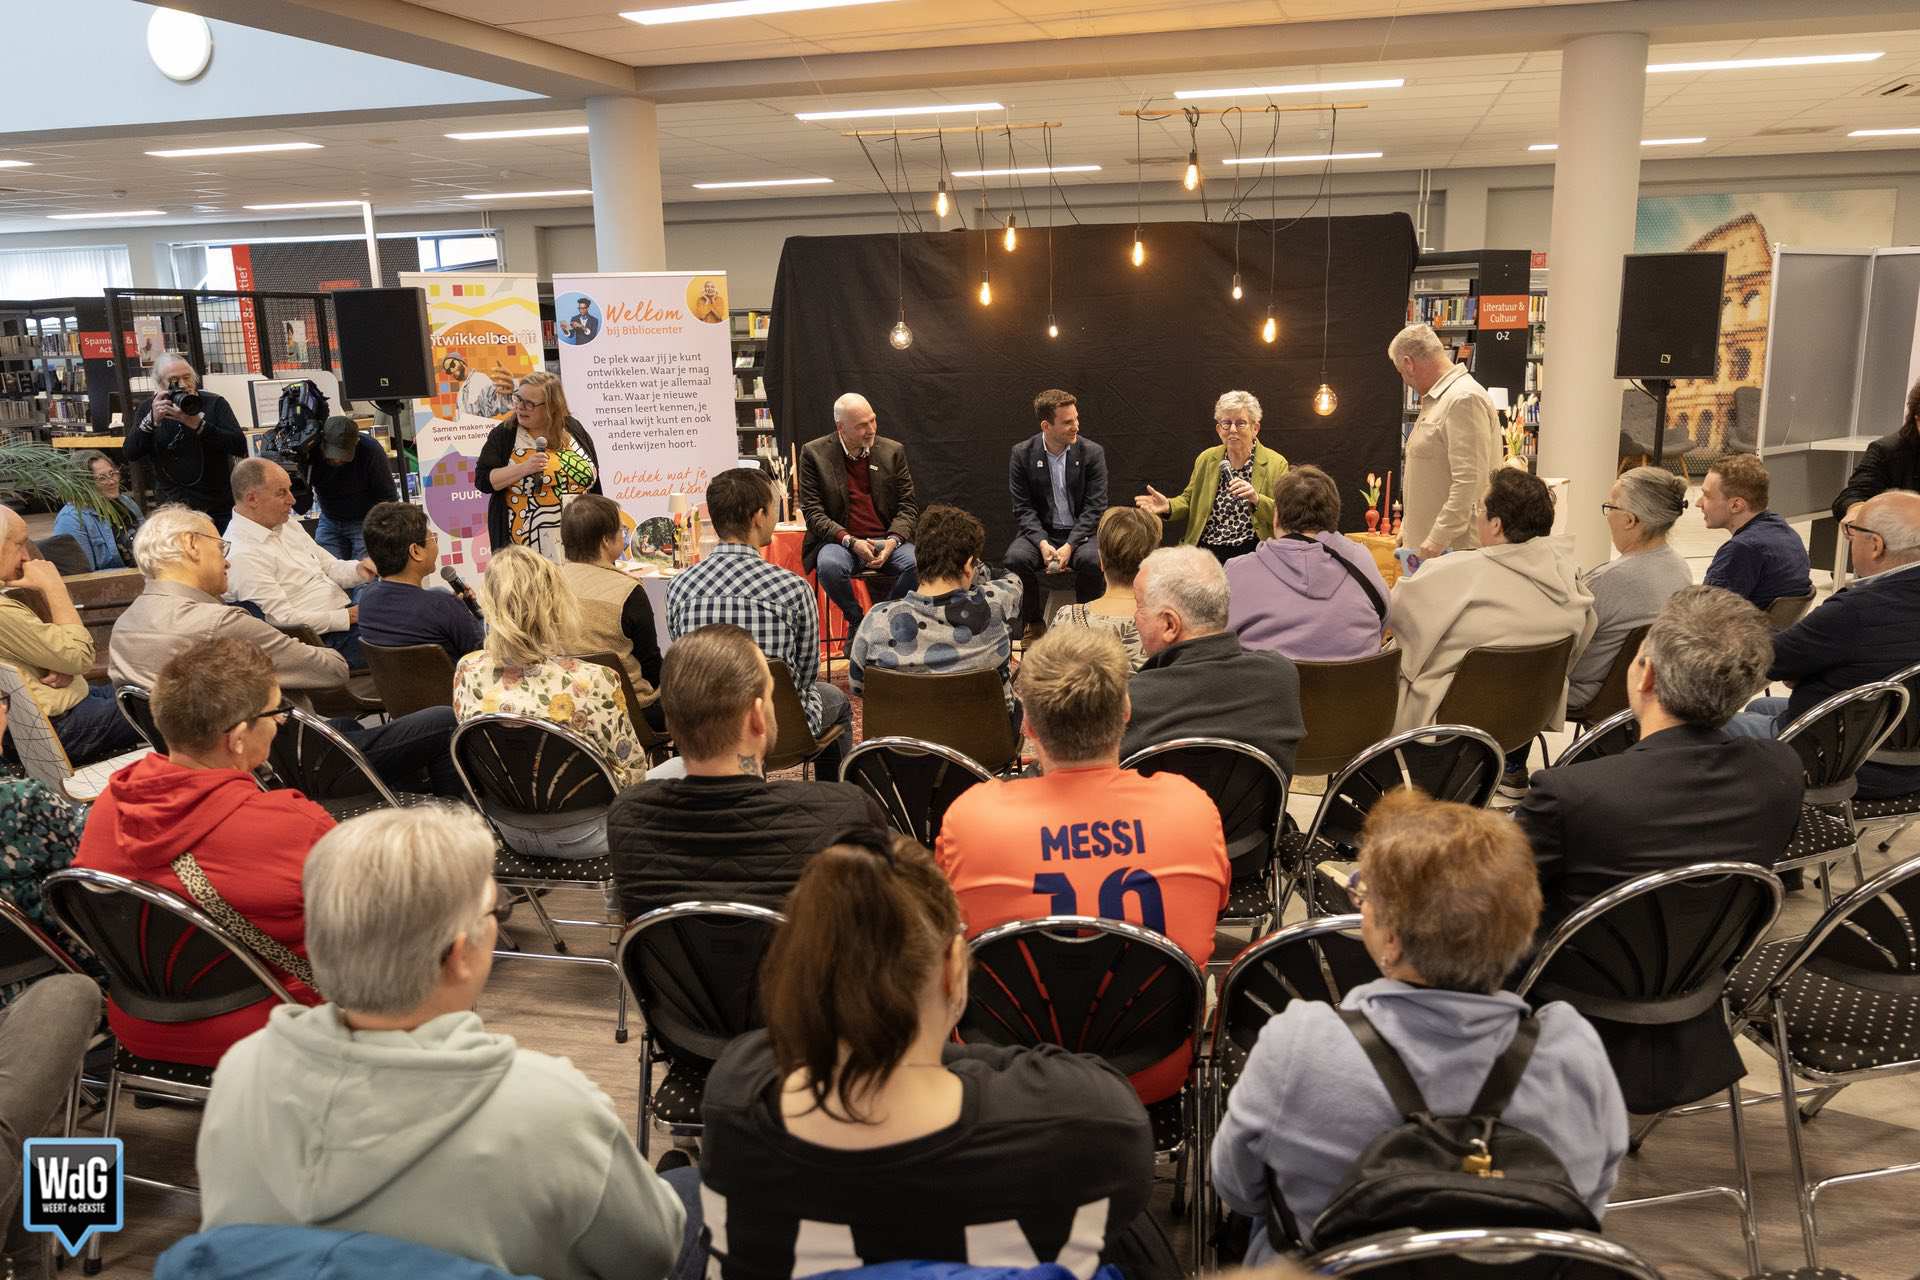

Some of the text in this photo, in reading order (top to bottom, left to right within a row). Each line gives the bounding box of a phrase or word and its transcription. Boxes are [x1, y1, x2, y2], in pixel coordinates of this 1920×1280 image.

[605, 300, 682, 323] Welkom
[1483, 301, 1525, 312] Literatuur &
[1490, 313, 1517, 323] Cultuur
[606, 325, 682, 337] bij Bibliocenter
[1496, 331, 1510, 341] O-Z
[126, 336, 133, 345] &
[430, 329, 536, 347] twikkelbedrijf
[593, 352, 701, 366] De plek waar jij je kunt
[587, 365, 709, 377] ontwikkelen. Waar je mag
[587, 377, 711, 390] ontdekken wat je allemaal
[603, 391, 698, 402] kan. Waar je nieuwe
[595, 402, 707, 415] mensen leert kennen, je
[592, 417, 627, 427] verhaal
[630, 416, 654, 427] kwijt
[656, 415, 678, 425] kunt
[694, 414, 711, 423] ook
[432, 425, 458, 433] Samen
[459, 424, 484, 432] maken
[608, 429, 641, 439] andere
[643, 428, 684, 437] verhalen
[433, 434, 451, 442] werk
[453, 433, 467, 441] van
[611, 439, 696, 452] denkwijzen hoort.
[613, 466, 707, 485] Ontdek wat je
[451, 489, 482, 501] PUUR
[615, 481, 708, 500] allemaal kan!
[1040, 819, 1146, 861] MESSI
[1032, 866, 1167, 937] 10
